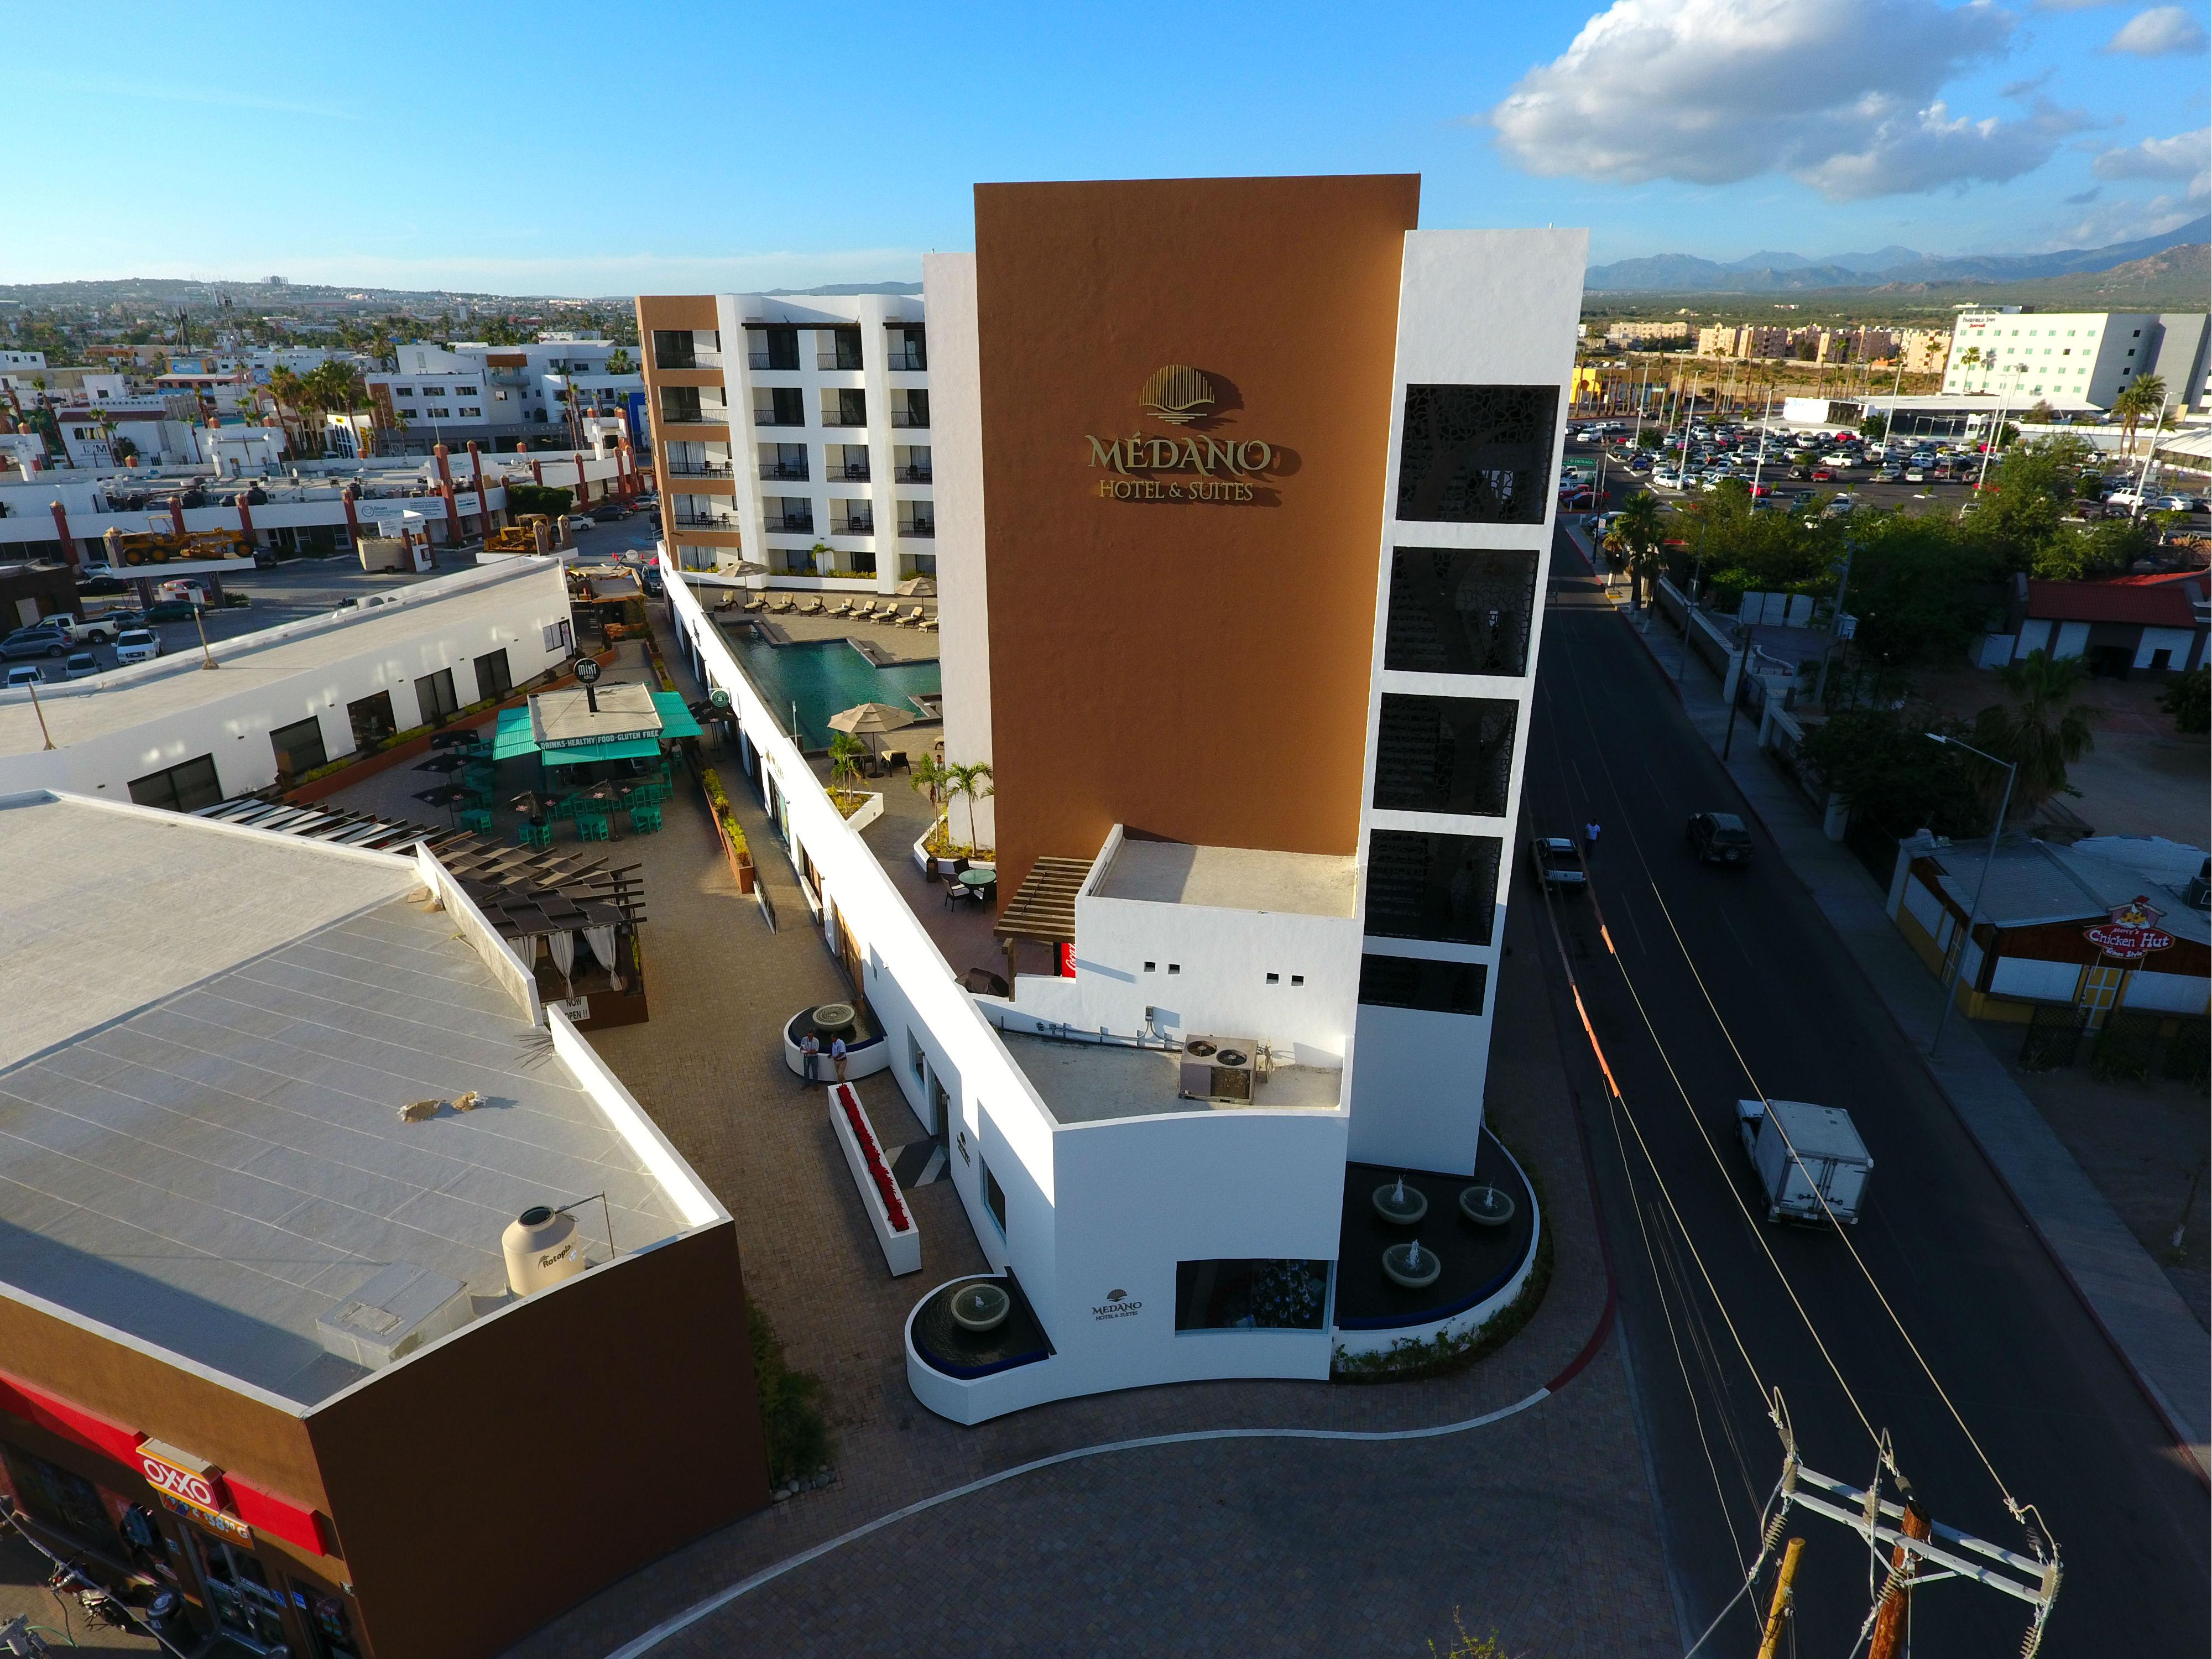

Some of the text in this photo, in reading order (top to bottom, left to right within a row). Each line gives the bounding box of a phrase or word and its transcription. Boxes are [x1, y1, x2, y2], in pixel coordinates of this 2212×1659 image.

[1084, 430, 1271, 476] MÉDANO
[1099, 479, 1253, 501] HOTEL & SUITES
[578, 662, 596, 676] MINT
[2089, 930, 2169, 947] Chicken Hut
[566, 998, 582, 1008] NOW
[565, 1010, 581, 1020] OPEN
[144, 1459, 211, 1504] OXXO
